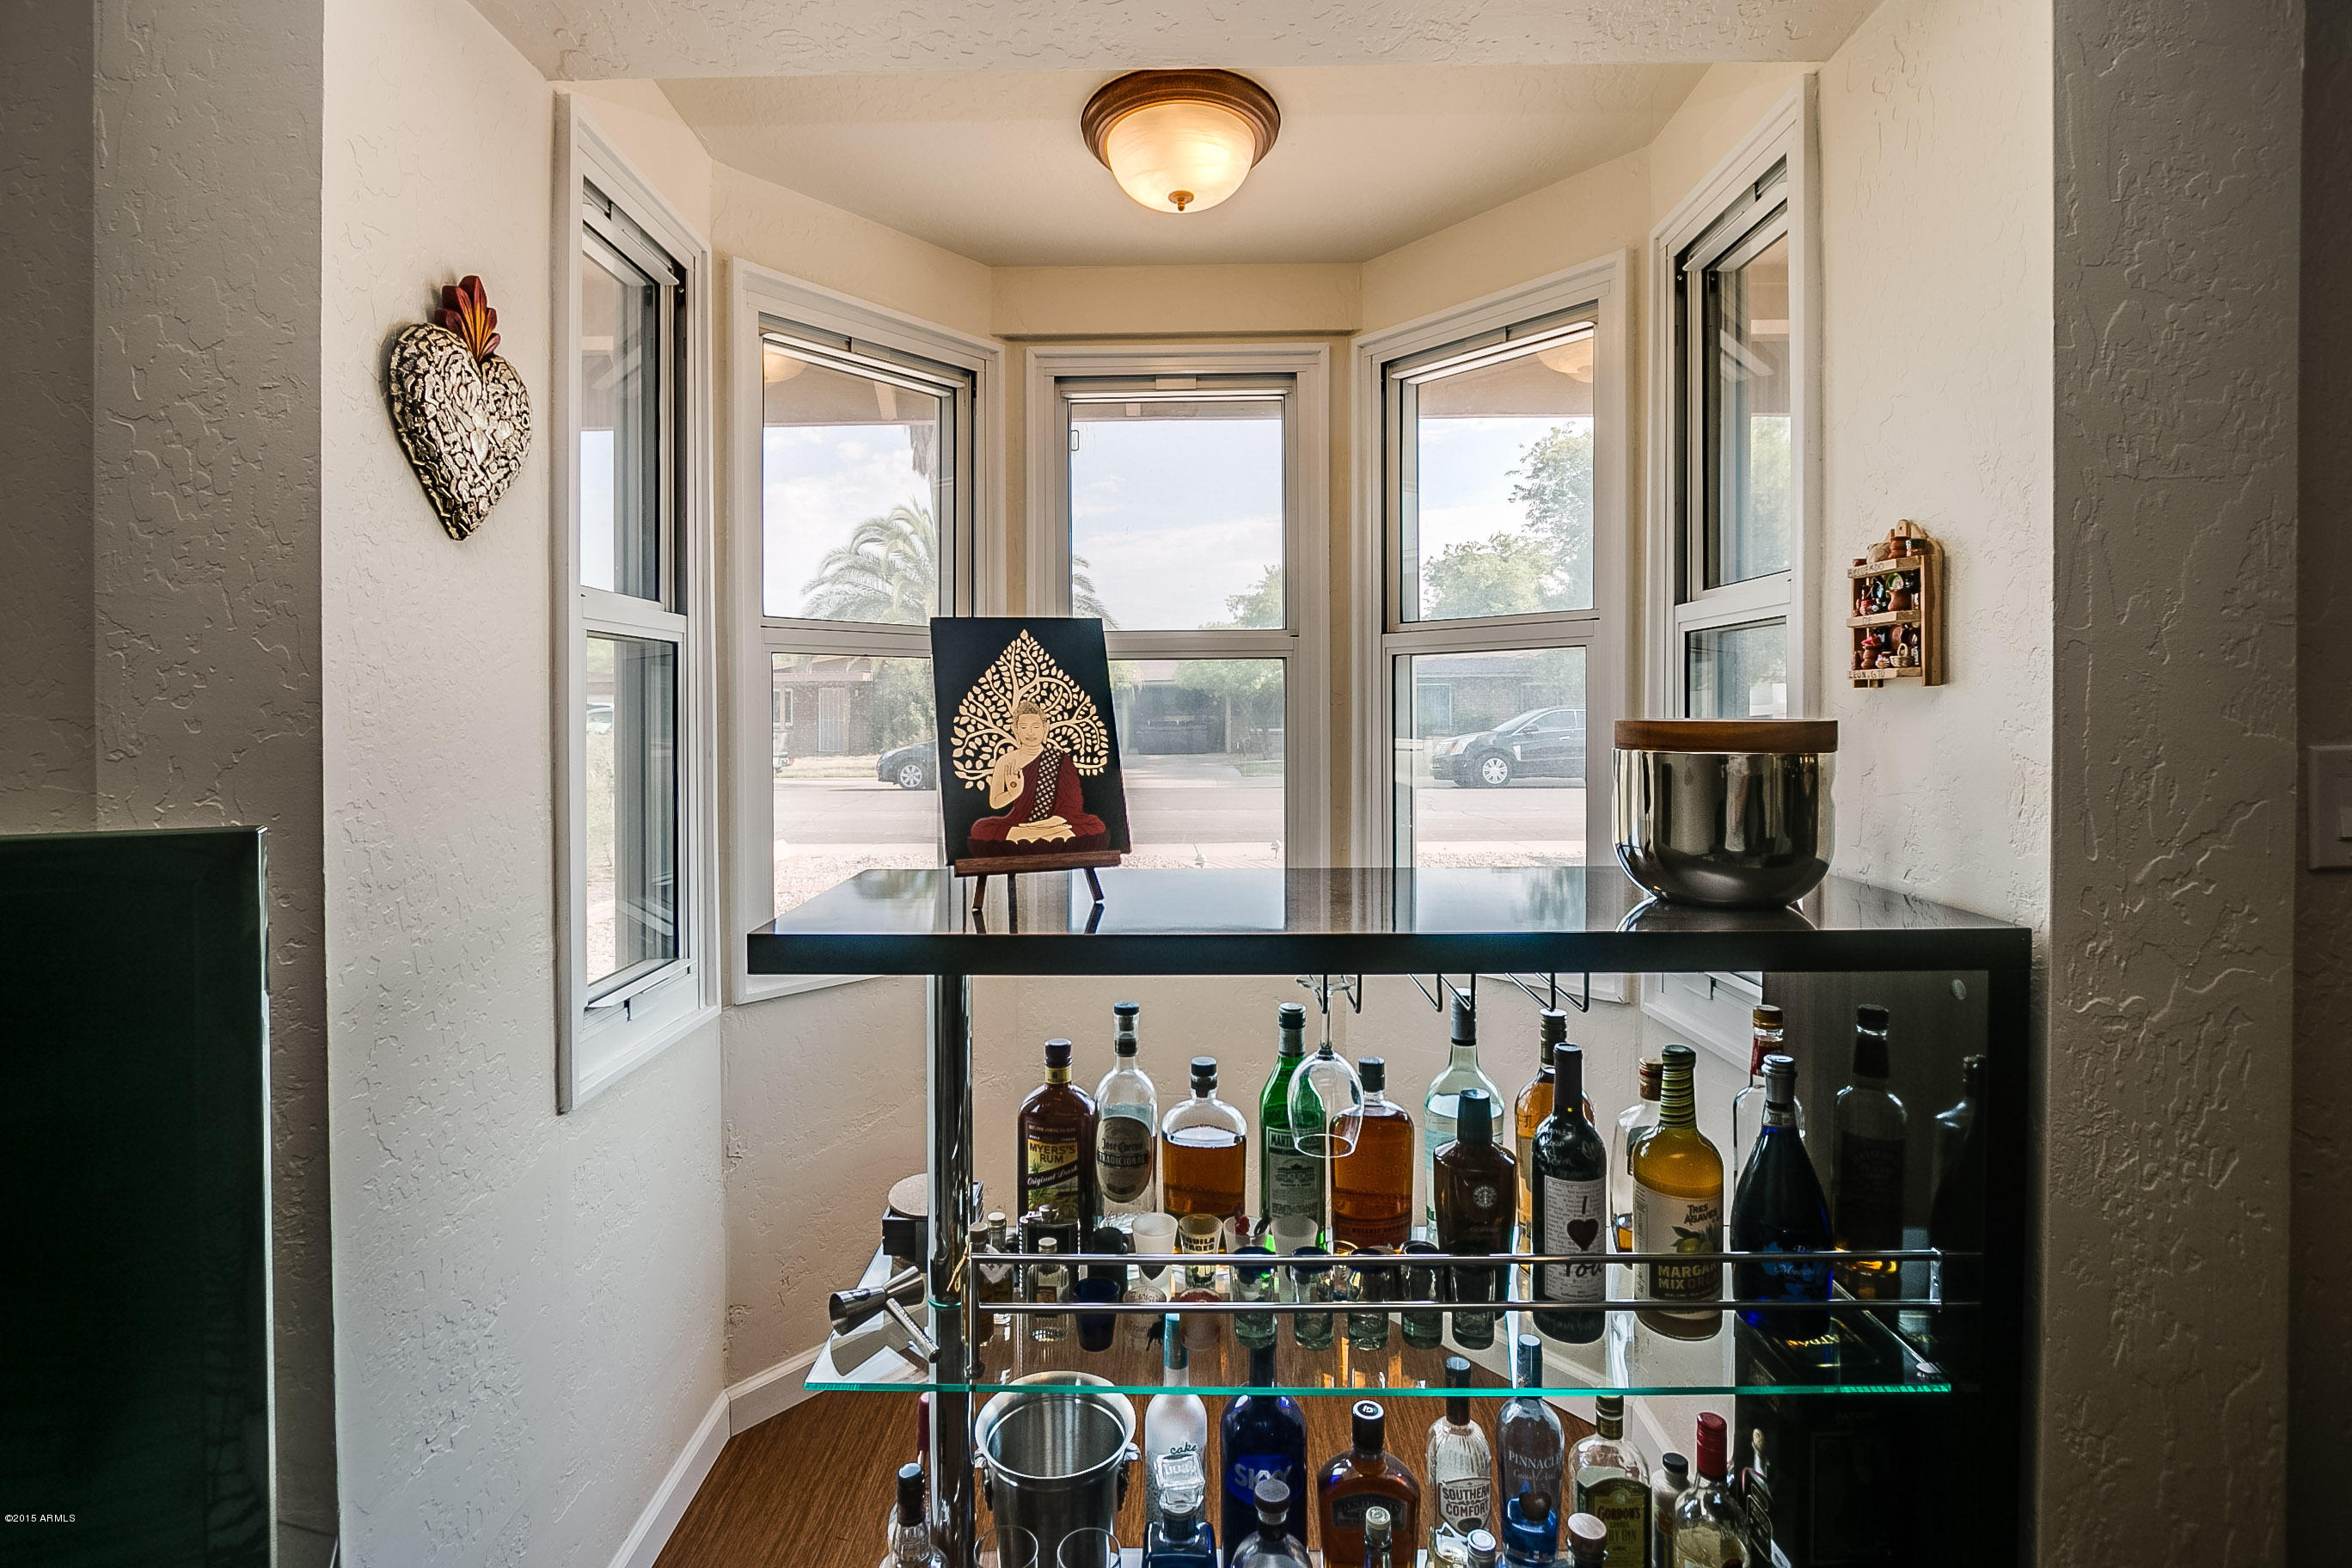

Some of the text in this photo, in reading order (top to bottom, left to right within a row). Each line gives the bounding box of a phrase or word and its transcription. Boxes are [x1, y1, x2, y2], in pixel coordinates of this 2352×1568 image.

[1029, 1142, 1076, 1155] MYERS'S
[1039, 1153, 1064, 1164] RUM
[1027, 1173, 1057, 1187] Original
[1582, 1195, 1589, 1215] I
[1687, 1204, 1709, 1217] TRES
[1684, 1207, 1718, 1226] AGAVES
[1658, 1277, 1685, 1290] MIX
[1170, 1441, 1197, 1455] cake
[1442, 1484, 1490, 1501] SOUTHERN
[1445, 1498, 1489, 1517] COMFORT
[1597, 1505, 1641, 1521] GORDON'S
